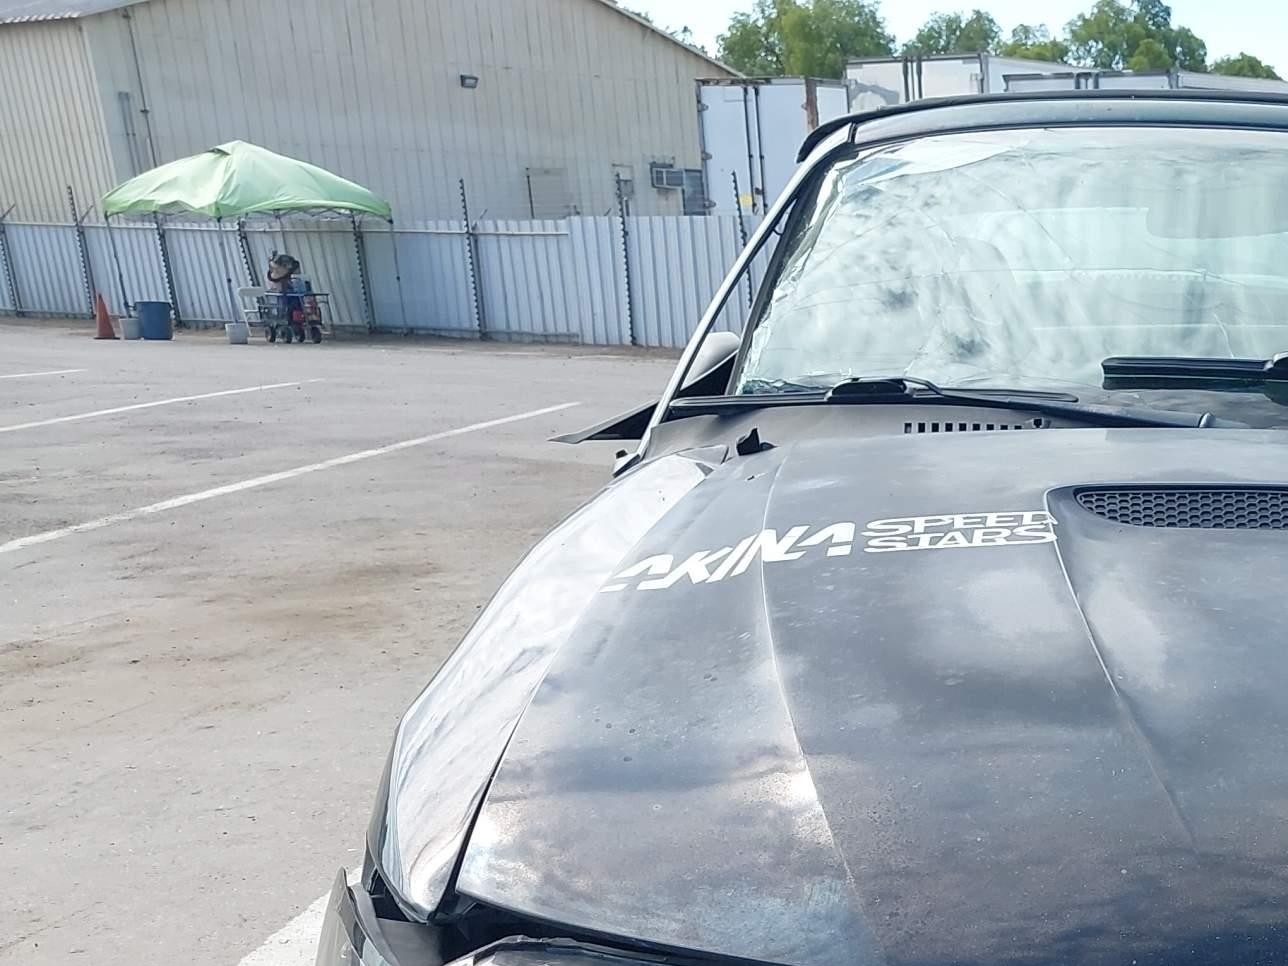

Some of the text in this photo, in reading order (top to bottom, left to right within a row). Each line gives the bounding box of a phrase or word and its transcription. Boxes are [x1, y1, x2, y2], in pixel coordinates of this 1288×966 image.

[861, 510, 1059, 538] SPEED
[863, 524, 1058, 553] STARS
[599, 522, 856, 594] AKINA
